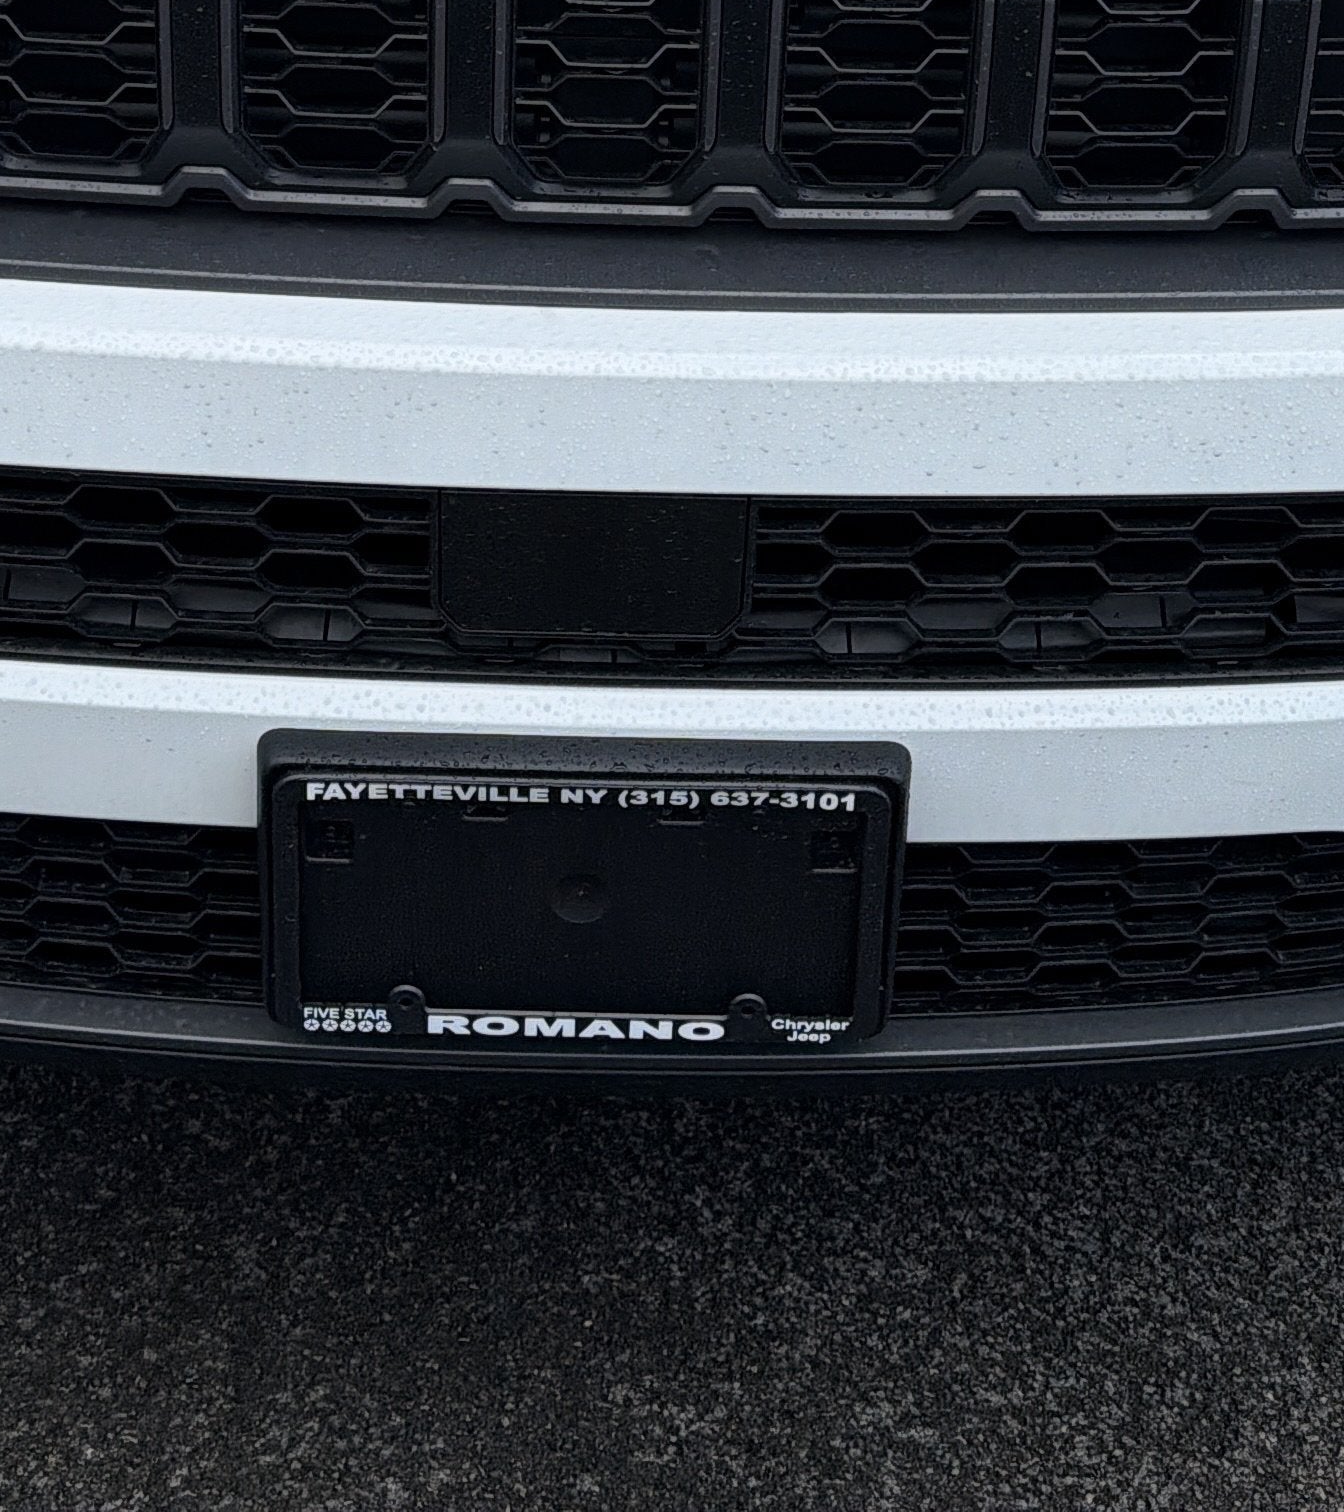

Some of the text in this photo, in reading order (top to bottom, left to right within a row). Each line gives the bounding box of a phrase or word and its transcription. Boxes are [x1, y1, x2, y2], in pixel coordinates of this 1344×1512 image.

[306, 782, 856, 812] FAYETTEVILLE NY (315) 637-3101
[303, 1007, 387, 1021] FIVE STAR
[426, 1014, 725, 1041] ROMANO
[770, 1017, 851, 1032] Chrysler
[786, 1030, 832, 1044] Jeep
